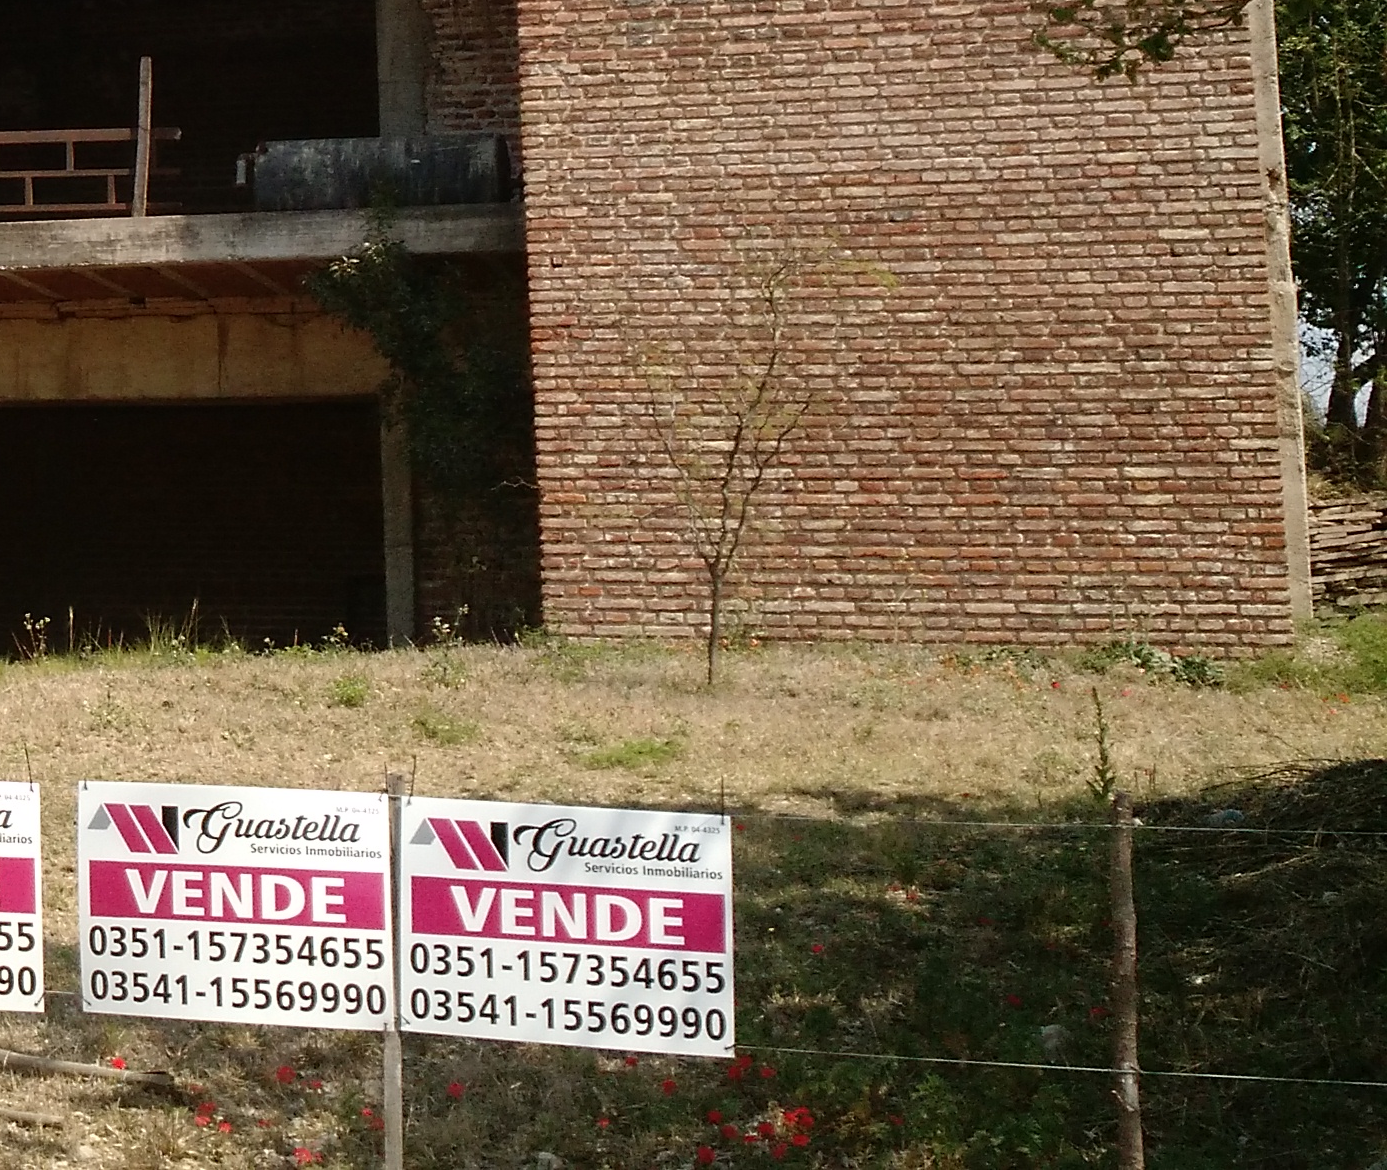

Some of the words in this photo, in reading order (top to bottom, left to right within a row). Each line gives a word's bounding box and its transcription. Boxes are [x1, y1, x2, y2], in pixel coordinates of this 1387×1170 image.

[182, 801, 361, 854] Guastella
[250, 843, 302, 856] Servicios
[305, 845, 383, 859] Inmobiliarios
[512, 818, 702, 872] Guastella
[124, 868, 347, 924] VENDE
[584, 862, 639, 876] Servicios
[642, 864, 723, 880] Inmobiliarios
[449, 885, 686, 946] VENDE
[88, 925, 385, 970] 0351-157354655
[409, 942, 725, 994] 0351-157354655
[90, 969, 386, 1015] 03541-15569990
[410, 988, 727, 1041] 03541-15569990
